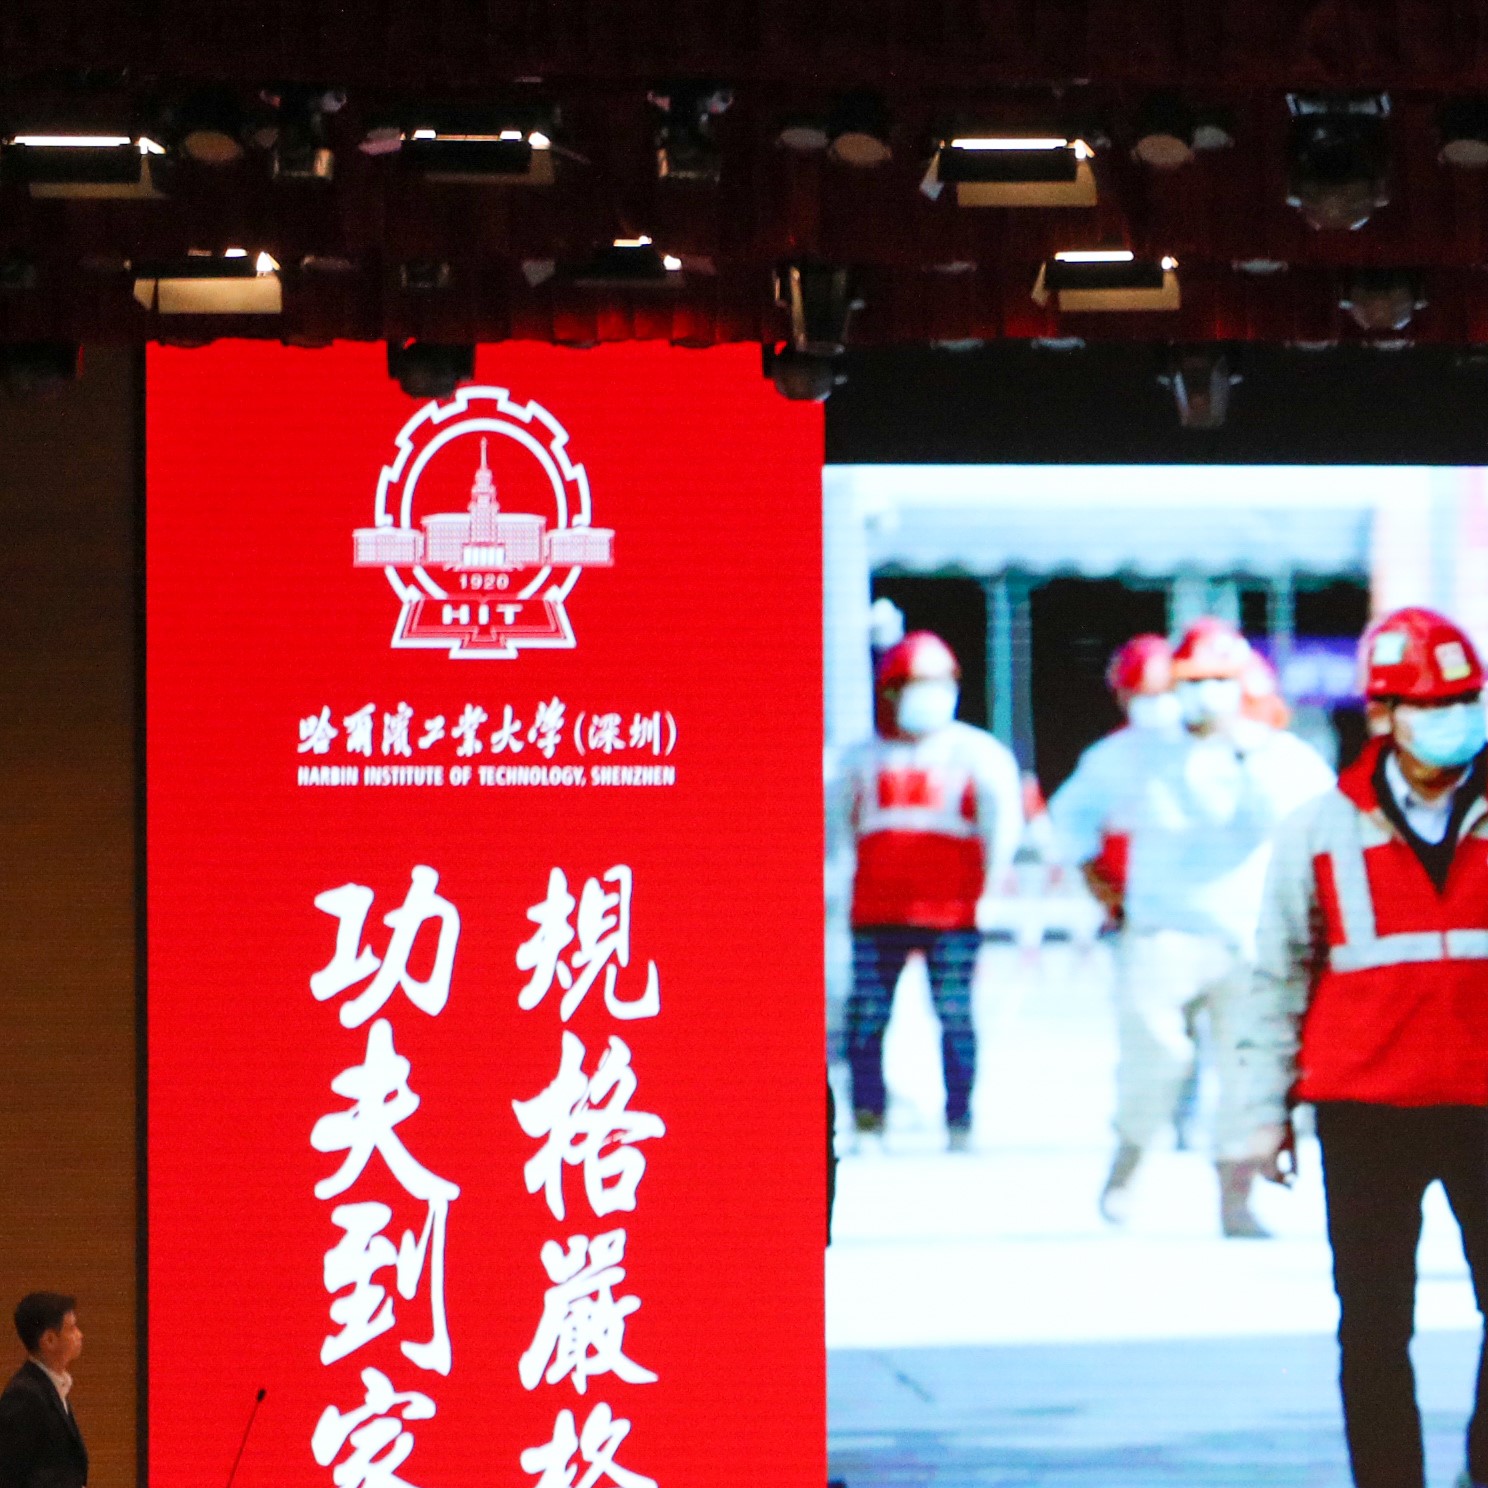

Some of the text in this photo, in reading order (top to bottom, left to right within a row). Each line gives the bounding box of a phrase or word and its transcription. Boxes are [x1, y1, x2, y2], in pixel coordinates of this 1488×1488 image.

[459, 573, 509, 590] 1920
[441, 603, 523, 625] HIT
[297, 765, 676, 789] HARBIN INSTITUTE OF TECHNOLOGY, SHENZHEN
